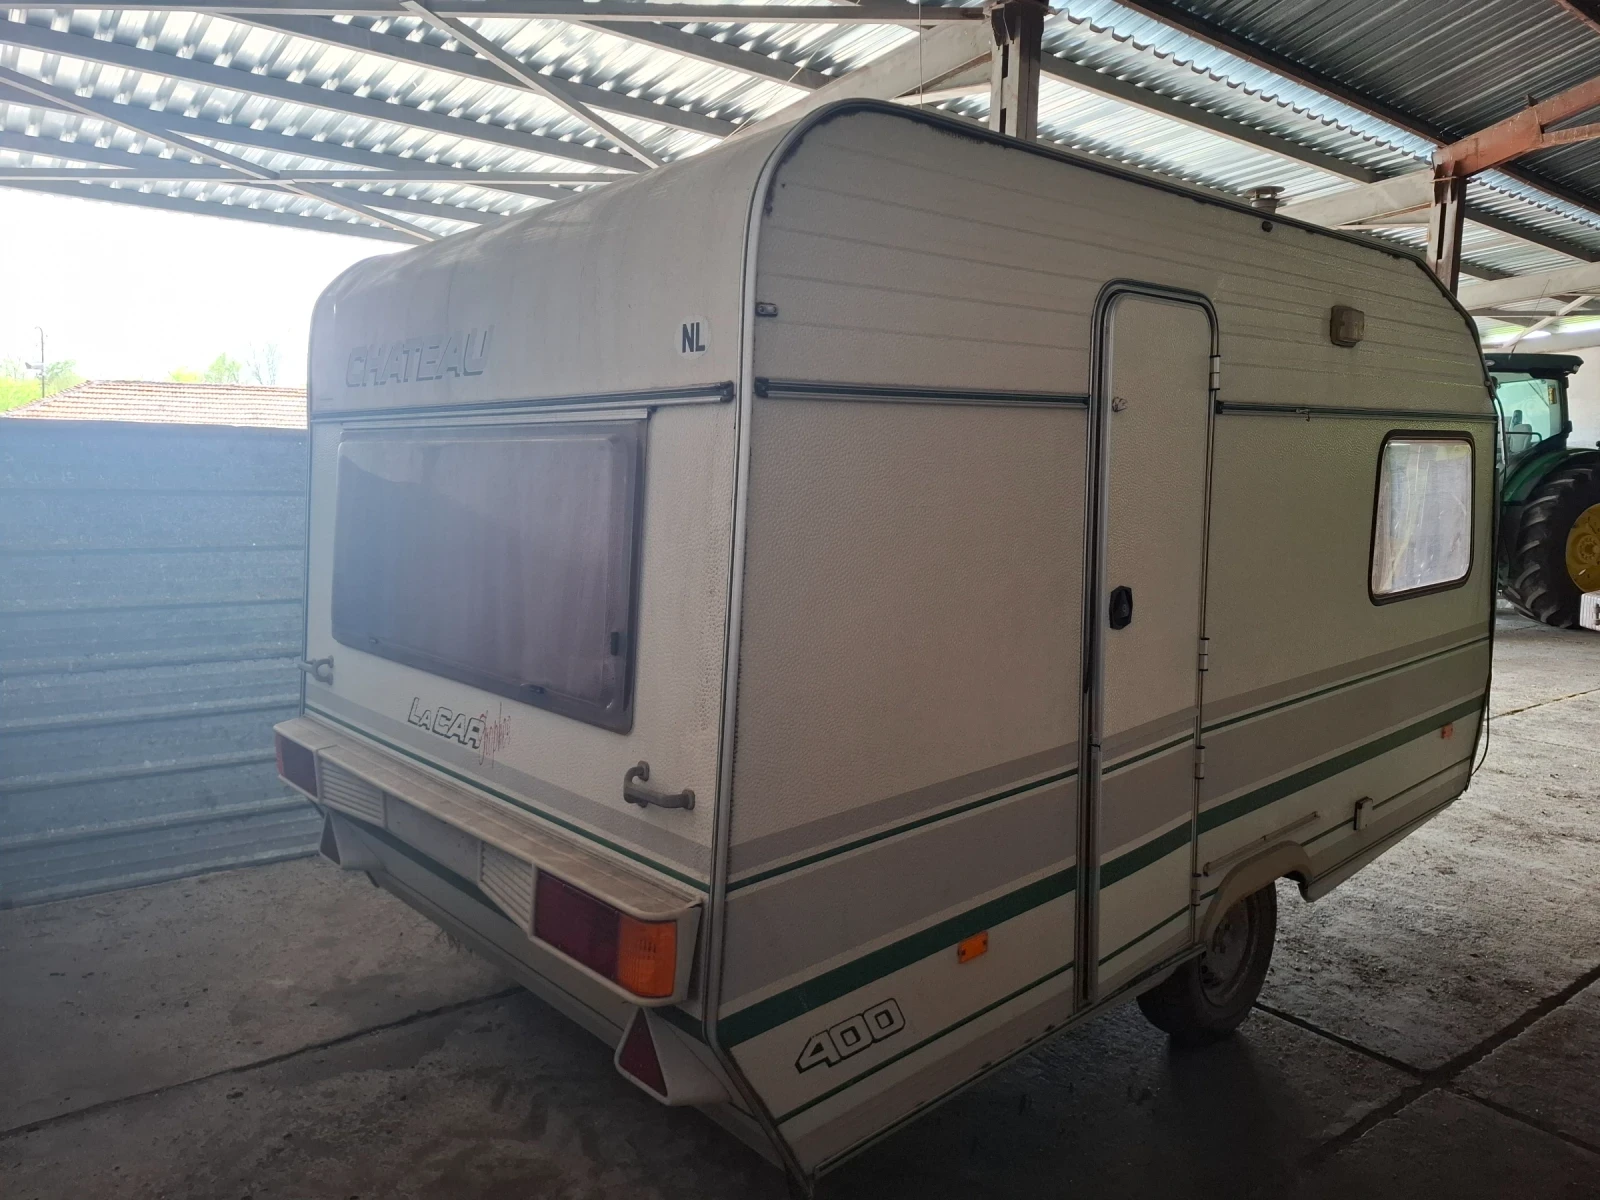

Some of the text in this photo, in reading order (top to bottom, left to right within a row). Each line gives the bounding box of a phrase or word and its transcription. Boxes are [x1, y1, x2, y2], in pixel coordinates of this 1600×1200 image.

[346, 324, 495, 388] CHATEAU
[682, 321, 706, 353] NL
[795, 998, 906, 1074] 400
